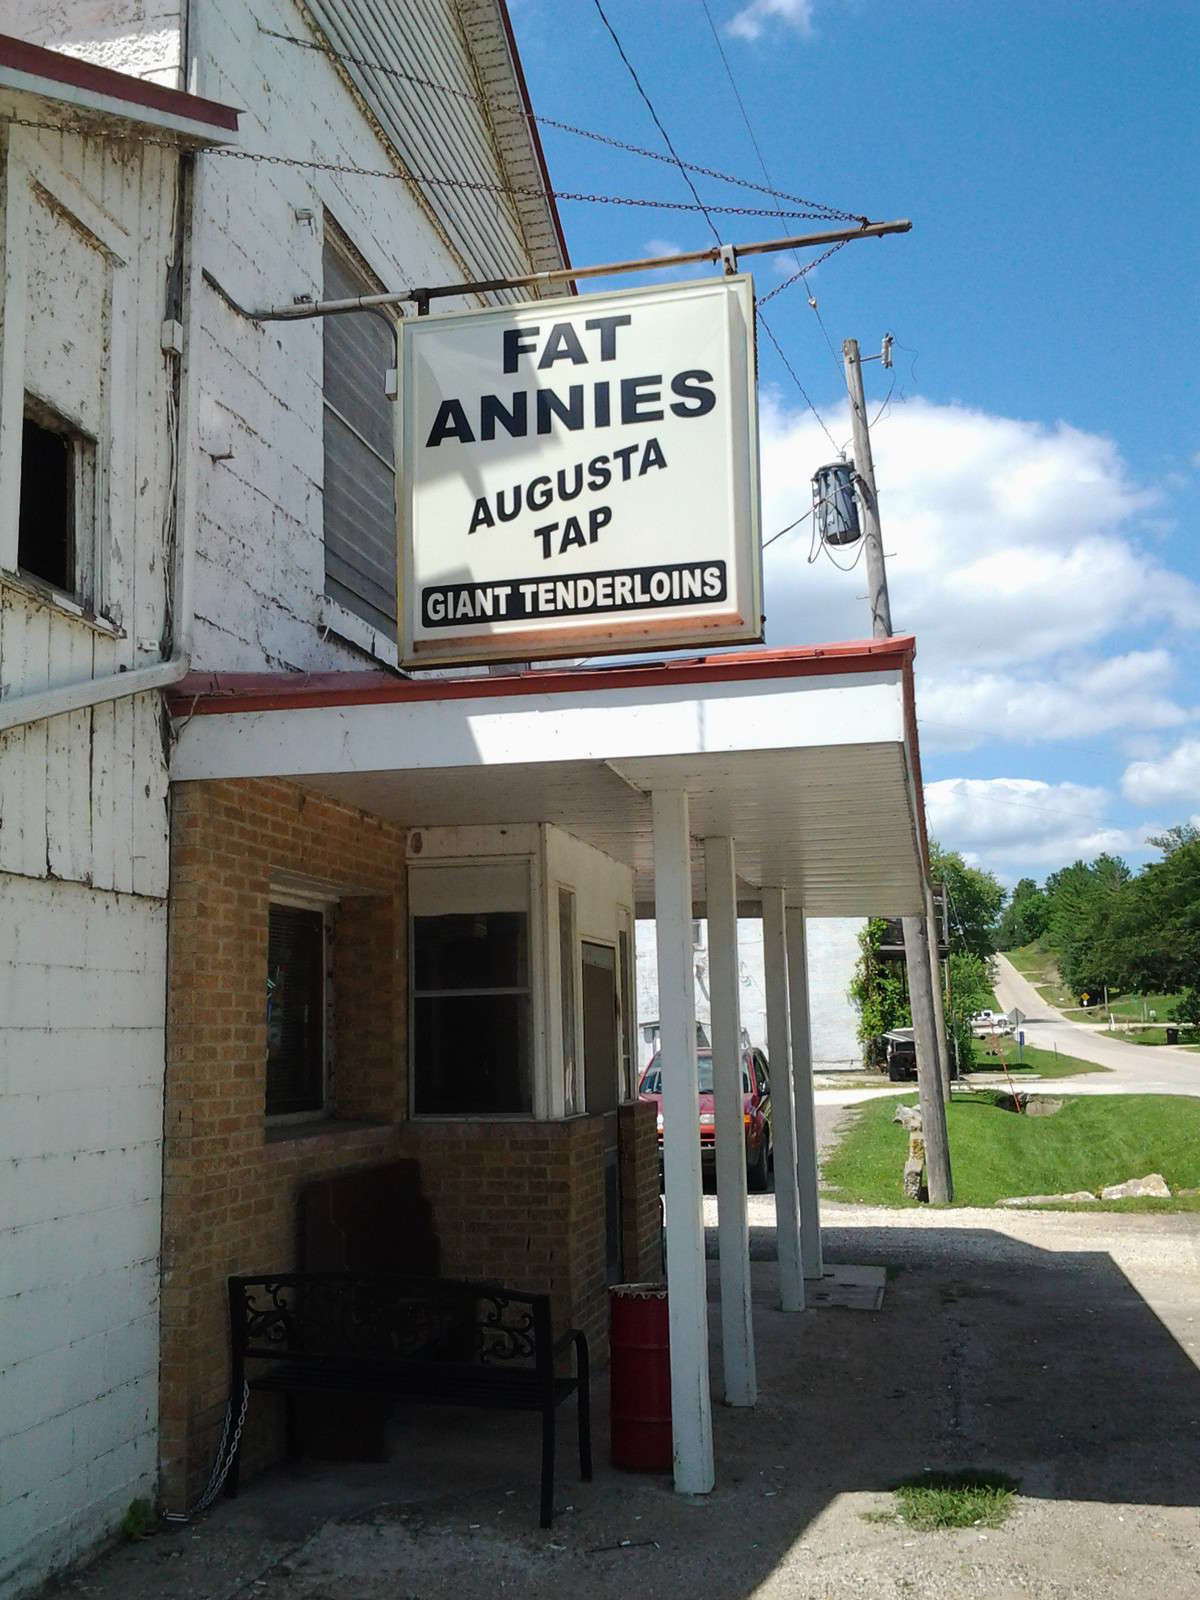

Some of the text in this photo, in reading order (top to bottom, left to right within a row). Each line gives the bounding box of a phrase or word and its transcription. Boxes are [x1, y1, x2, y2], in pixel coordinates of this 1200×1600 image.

[503, 314, 631, 374] FAT
[425, 369, 716, 448] ANNIES
[468, 438, 667, 534] AUGUSTA
[534, 506, 612, 560] TAP
[426, 567, 722, 621] GIANT TENDERLOINS
